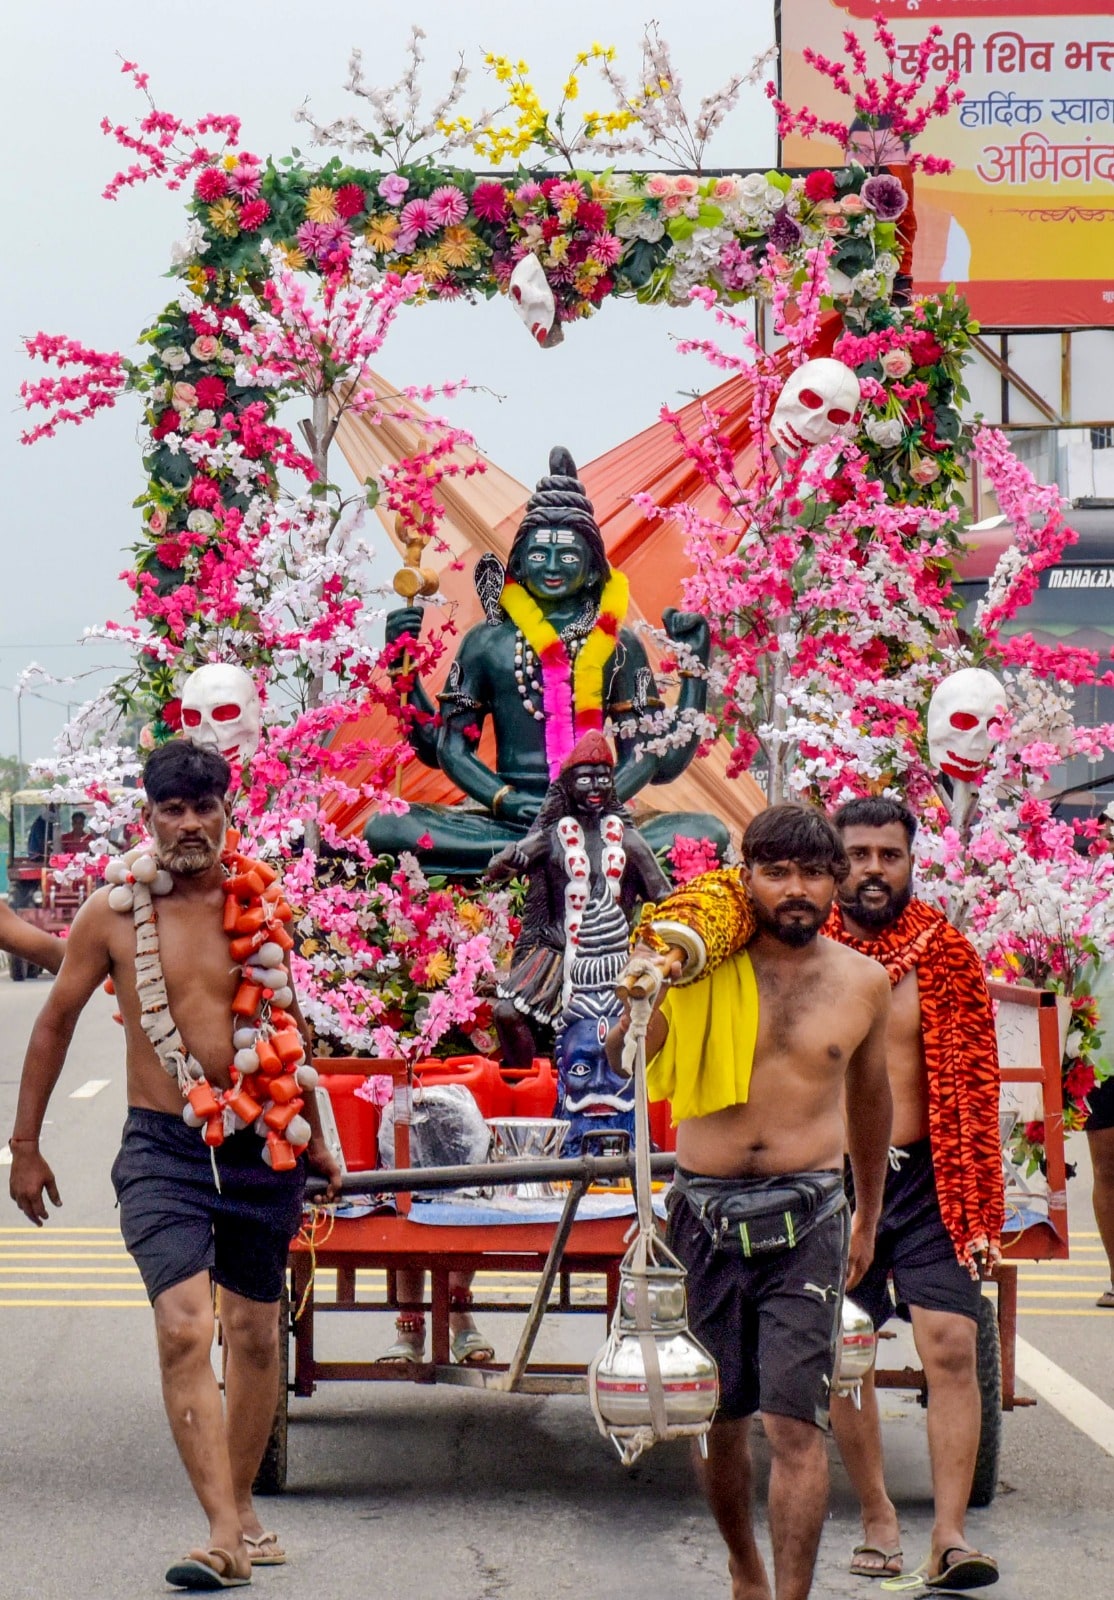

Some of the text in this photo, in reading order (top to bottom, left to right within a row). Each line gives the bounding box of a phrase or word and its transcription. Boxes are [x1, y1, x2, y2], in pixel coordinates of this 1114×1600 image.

[898, 32, 975, 74] सभी
[983, 31, 1055, 73] शिव
[960, 91, 1044, 128] हार्दिक
